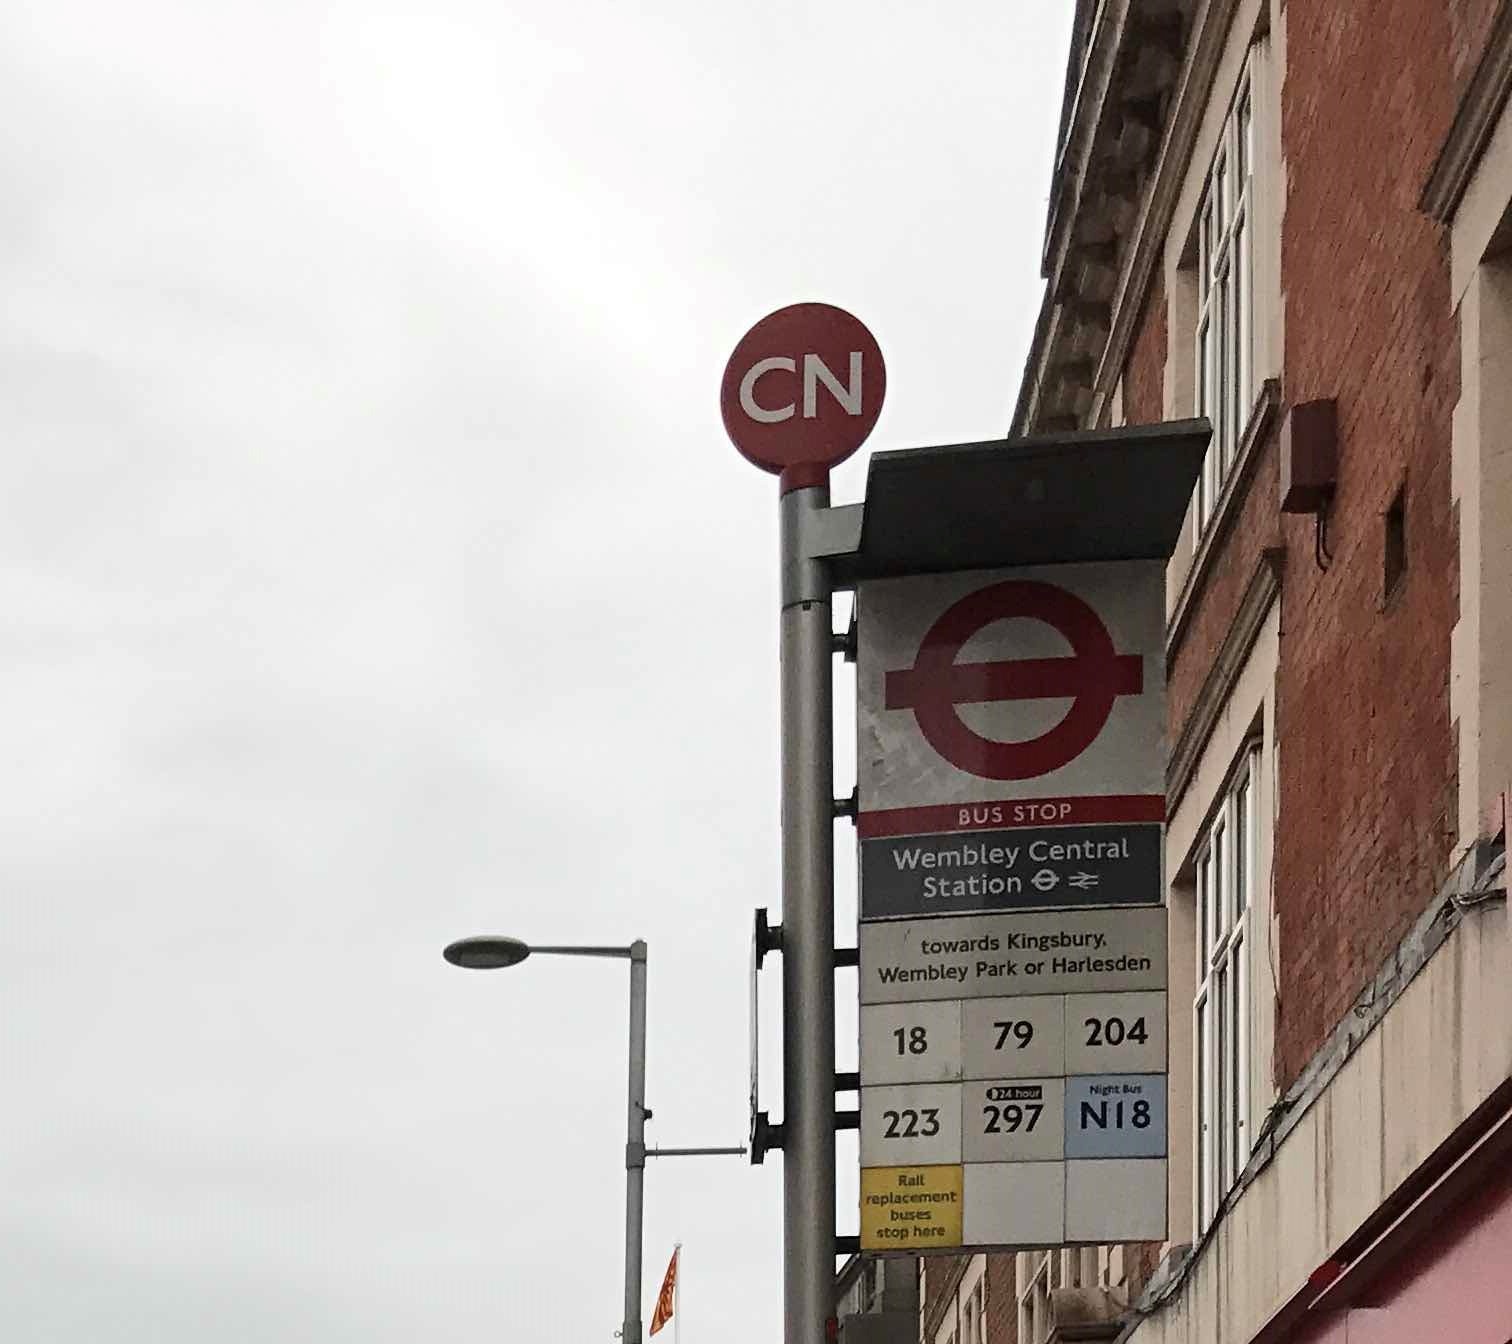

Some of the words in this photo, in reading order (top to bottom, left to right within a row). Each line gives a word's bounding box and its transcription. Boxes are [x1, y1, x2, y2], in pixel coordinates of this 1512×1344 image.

[739, 351, 863, 424] CN
[959, 806, 1001, 825] BUS
[1014, 803, 1072, 821] STOP
[894, 843, 1018, 870] Wembley
[1029, 838, 1129, 862] Central
[924, 875, 1021, 898] Station
[922, 935, 999, 954] towards
[879, 965, 967, 984] Wembley
[977, 961, 1018, 976] Park
[1025, 963, 1044, 975] or
[1053, 957, 1150, 974] Harlesden
[894, 1028, 927, 1055] 18
[993, 1021, 1034, 1049] 79
[1085, 1018, 1148, 1046] 204
[1000, 1088, 1012, 1098] 24
[1016, 1088, 1040, 1098] hour
[1090, 1085, 1119, 1095] Night
[1123, 1085, 1142, 1095] Bus
[883, 1109, 940, 1138] 223
[983, 1105, 1044, 1133] 297
[1081, 1102, 1151, 1129] N18
[899, 1173, 924, 1186] Rail
[866, 1191, 956, 1206] replacement
[890, 1208, 931, 1221] buses
[876, 1225, 908, 1239] stop
[913, 1224, 945, 1238] here
